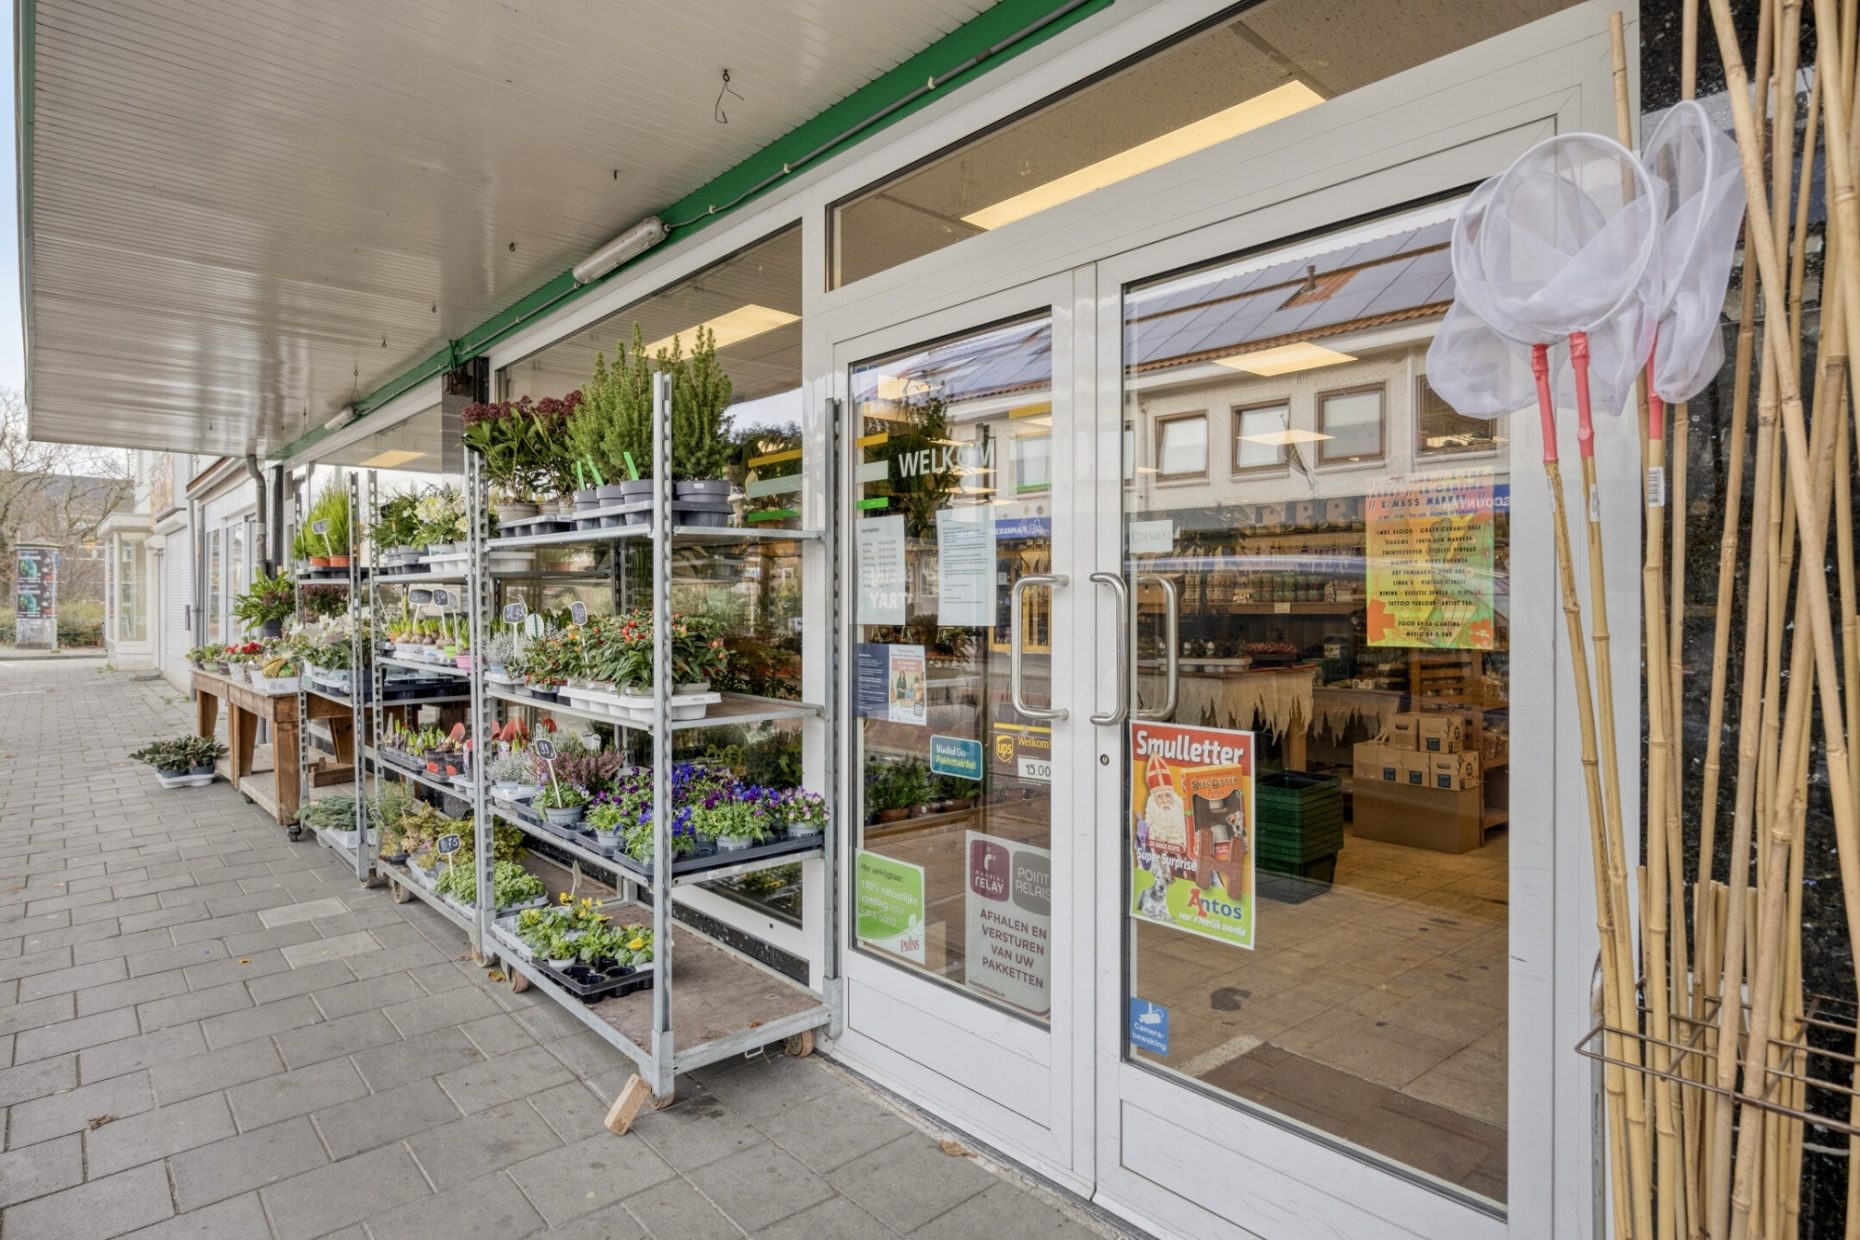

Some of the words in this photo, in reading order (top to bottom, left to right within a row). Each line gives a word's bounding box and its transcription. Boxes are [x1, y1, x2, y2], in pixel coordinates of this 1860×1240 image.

[899, 437, 996, 478] WELKOM
[1136, 730, 1245, 765] Smulletter
[1136, 847, 1160, 863] Super
[1161, 852, 1198, 872] Surprise
[1017, 866, 1050, 887] POINT
[1187, 888, 1242, 920] Antos
[980, 908, 1029, 934] AFHALEN
[1032, 926, 1047, 940] EN
[981, 924, 1045, 956] VERSTUREN
[990, 943, 1013, 961] VAN
[1015, 952, 1035, 969] UW
[982, 956, 1044, 990] PAKKETTEN
